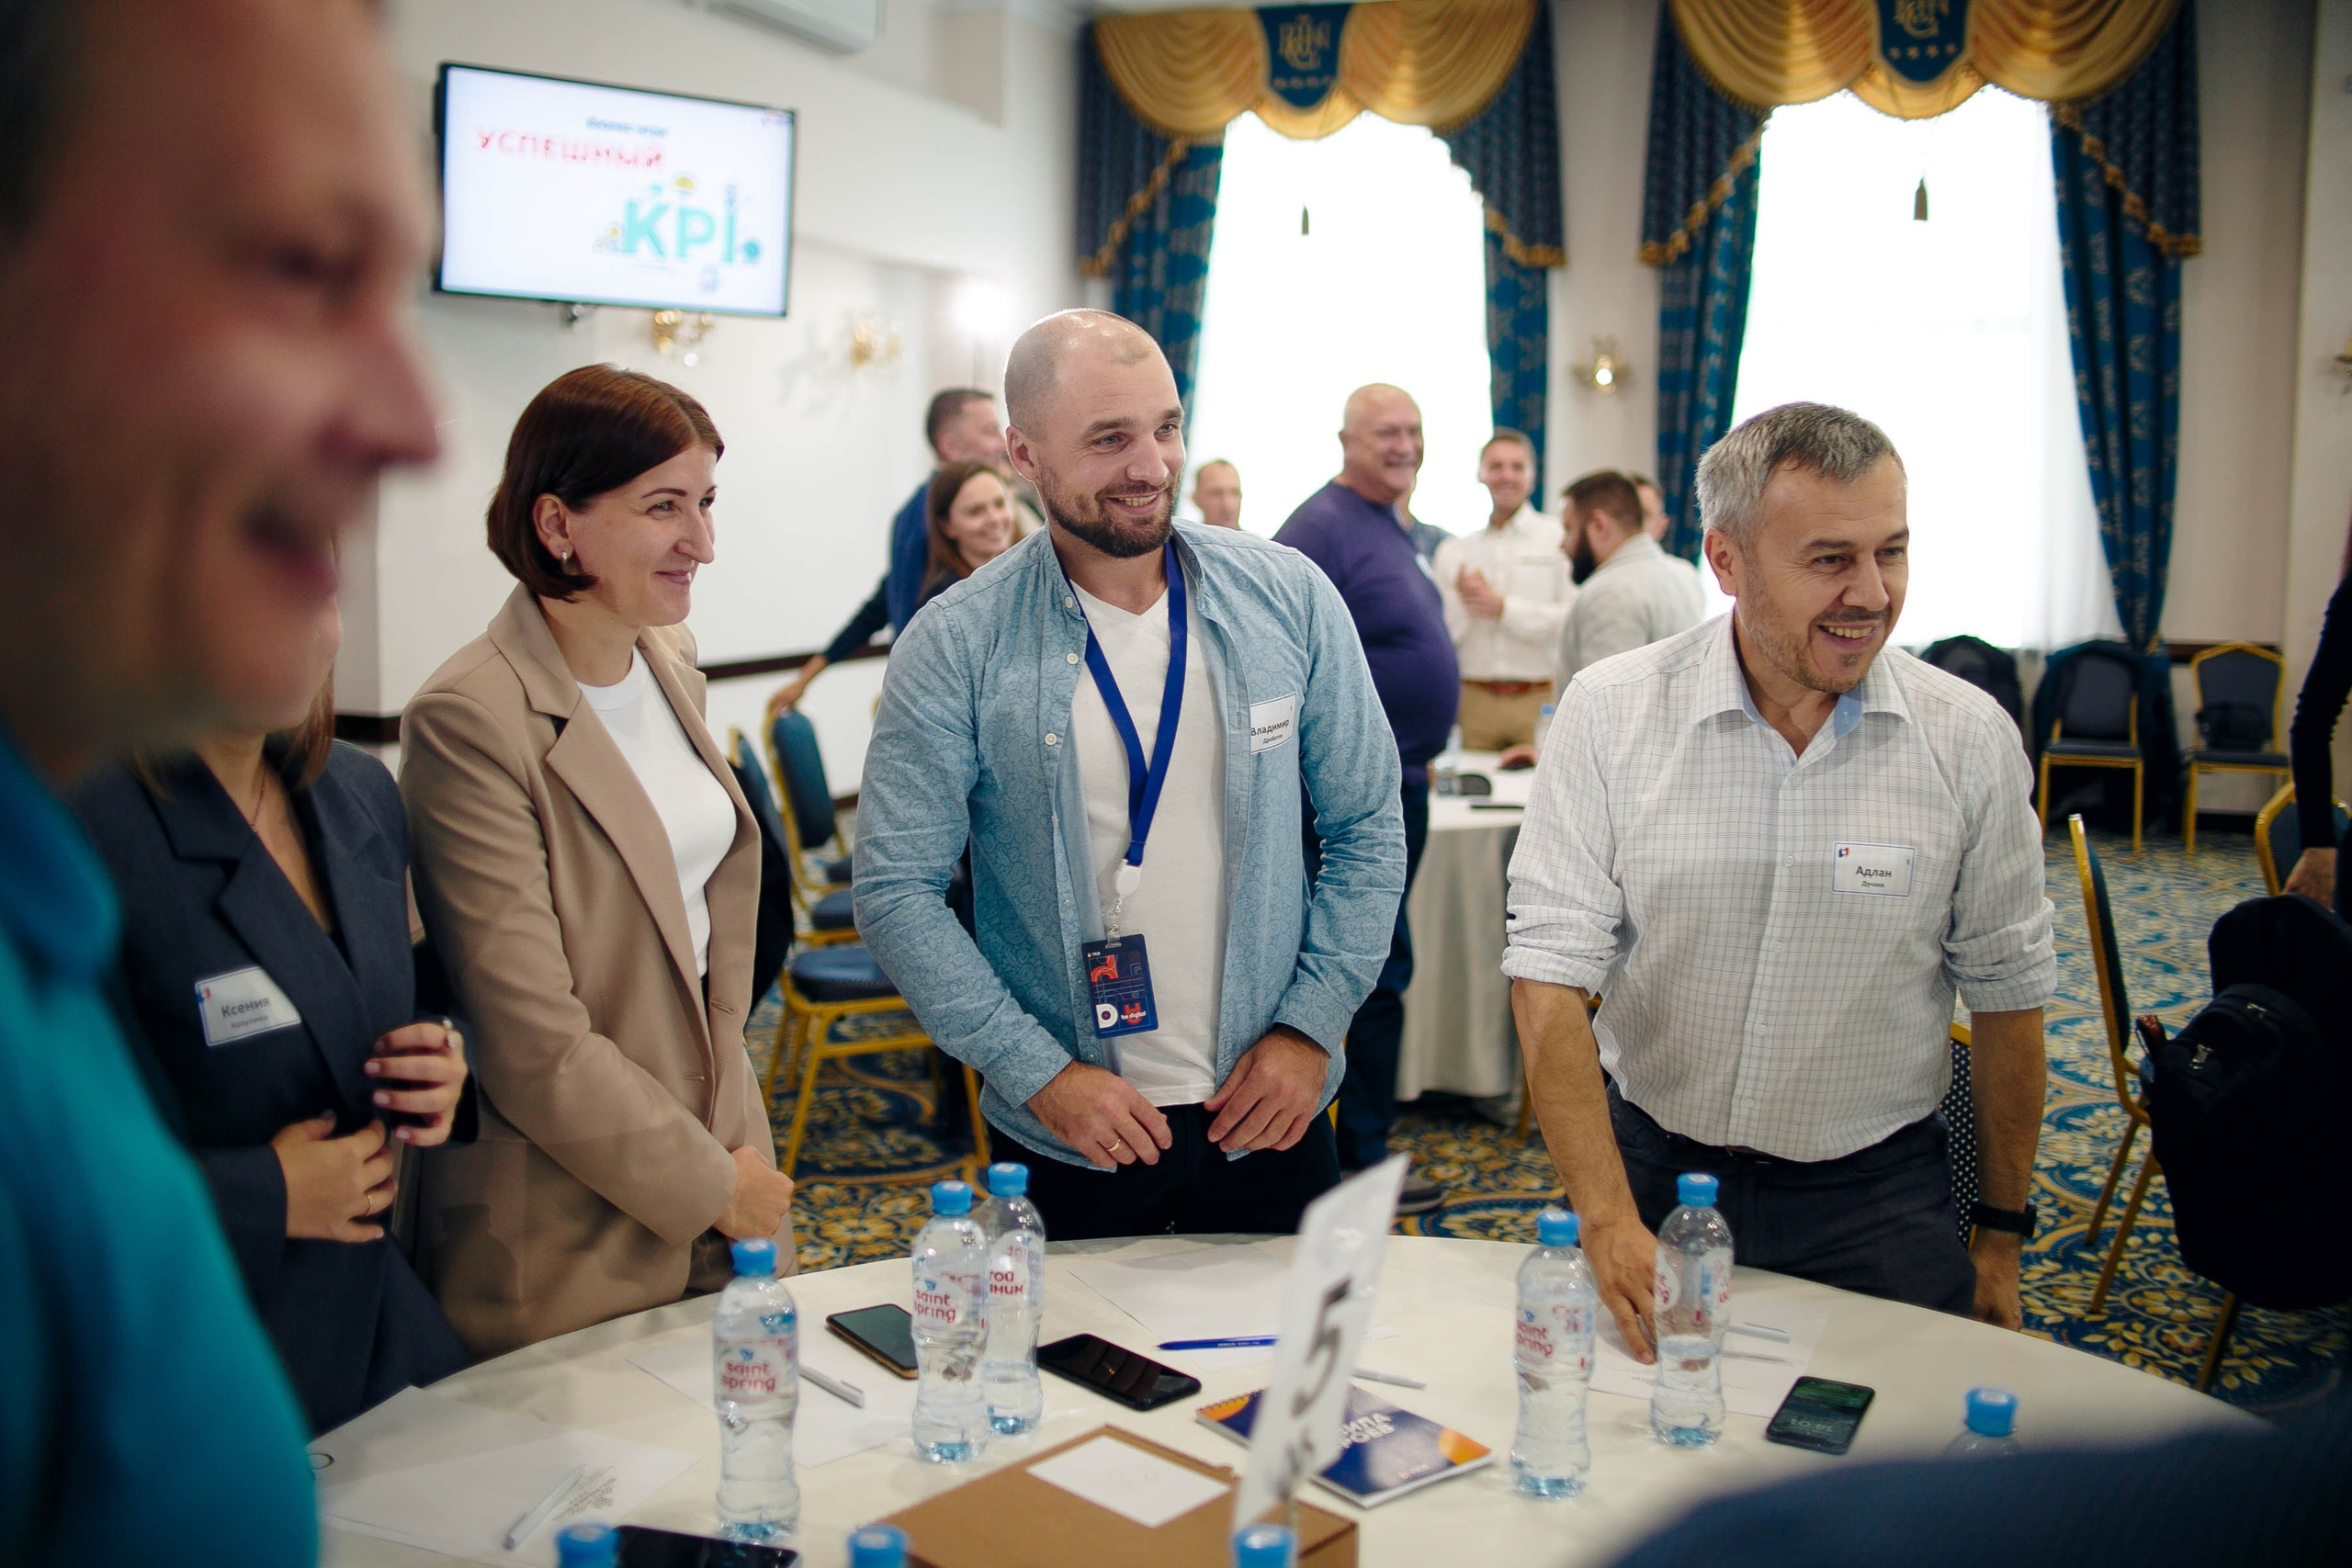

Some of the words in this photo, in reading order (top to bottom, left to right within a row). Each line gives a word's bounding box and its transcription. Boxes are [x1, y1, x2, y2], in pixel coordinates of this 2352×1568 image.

[1250, 719, 1290, 736] Владимир
[1856, 866, 1893, 877] Адлан
[221, 998, 270, 1018] Ксения
[726, 1361, 770, 1375] saint
[721, 1375, 777, 1393] spring
